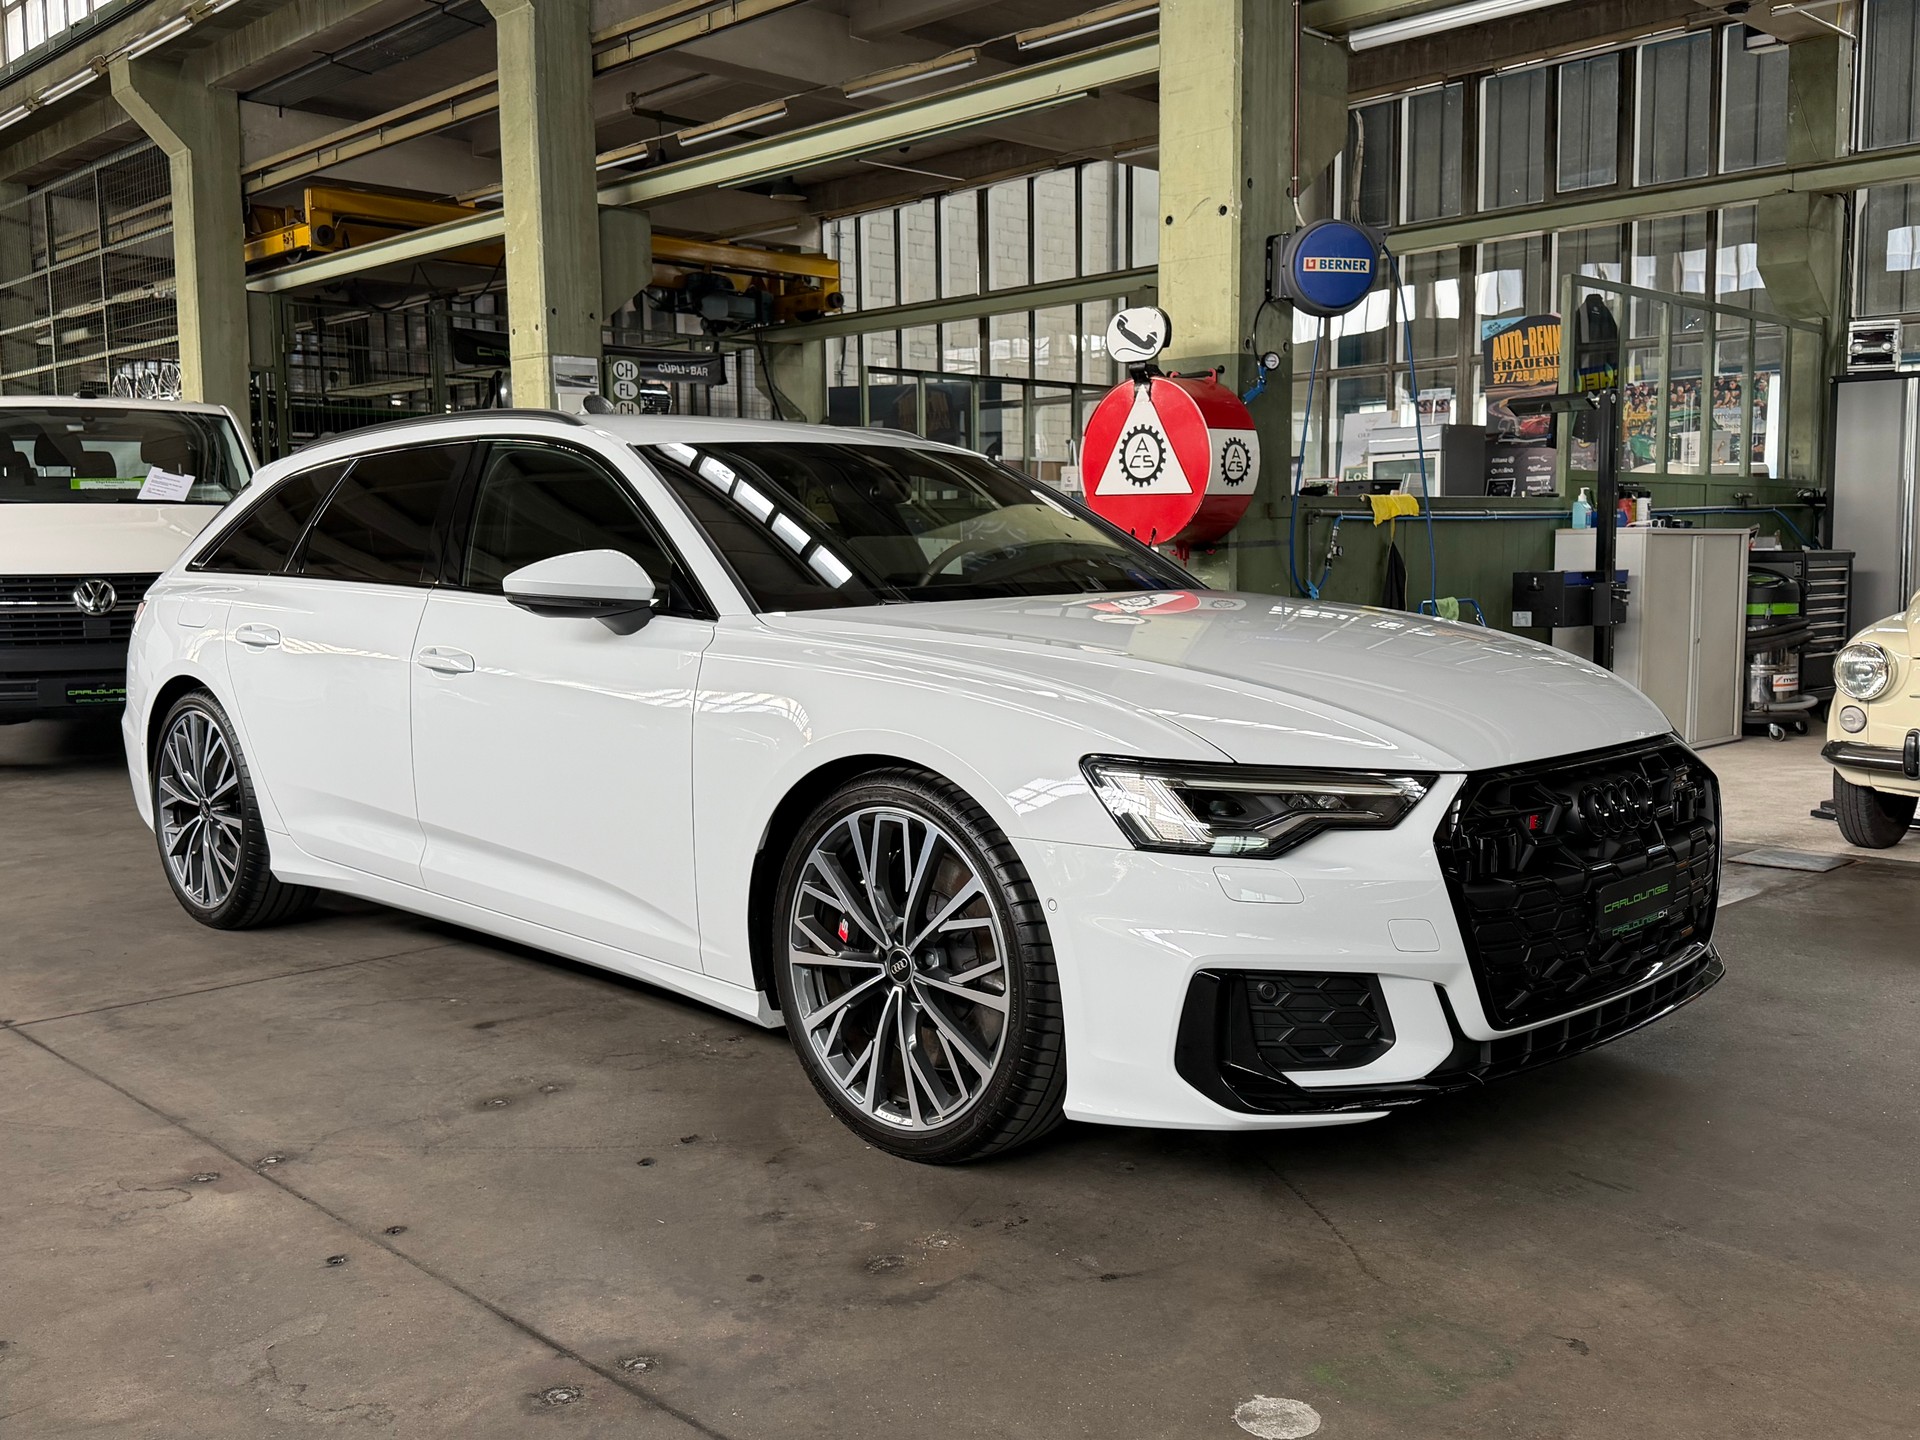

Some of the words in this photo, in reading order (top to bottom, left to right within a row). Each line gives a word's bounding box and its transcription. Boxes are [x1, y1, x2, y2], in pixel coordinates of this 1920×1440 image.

[1319, 258, 1367, 271] BERNER
[616, 362, 633, 379] CH
[657, 362, 708, 377] CÜPLI-BAR
[619, 382, 633, 398] FL
[67, 688, 128, 696] CARLOUNG
[1604, 883, 1669, 914] CARLOUNGE
